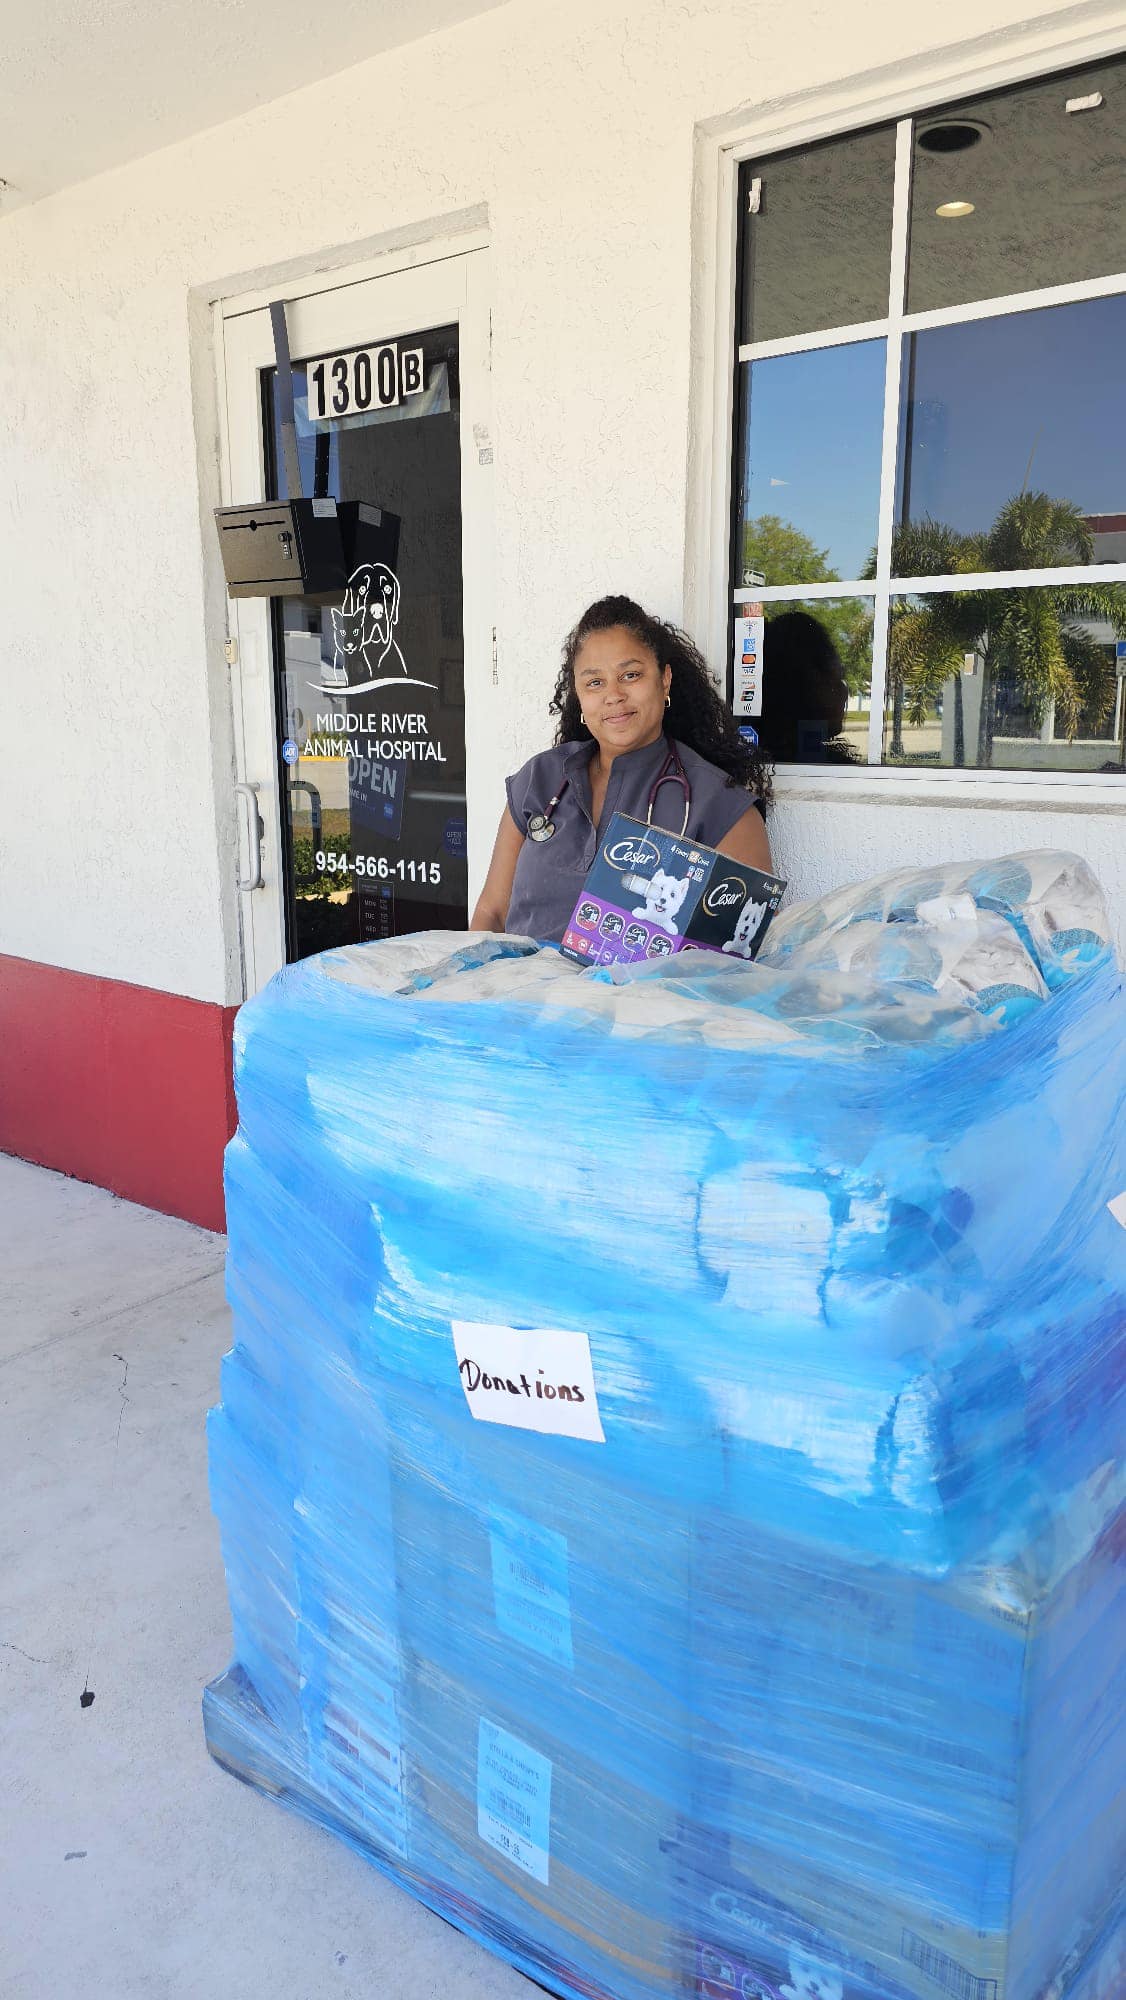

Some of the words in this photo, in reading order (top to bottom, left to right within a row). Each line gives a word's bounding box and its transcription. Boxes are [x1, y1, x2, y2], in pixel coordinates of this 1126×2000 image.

[311, 347, 396, 416] 1300
[404, 353, 421, 392] B
[316, 712, 377, 733] MIDDLE
[381, 713, 428, 735] RIVER
[303, 739, 364, 758] ANIMAL
[367, 740, 447, 762] HOSPITAL
[348, 757, 397, 798] OPEN
[315, 851, 441, 885] 954-566-1115
[610, 841, 656, 868] Cesar
[707, 883, 743, 908] Cesar
[459, 1358, 585, 1403] Donations
